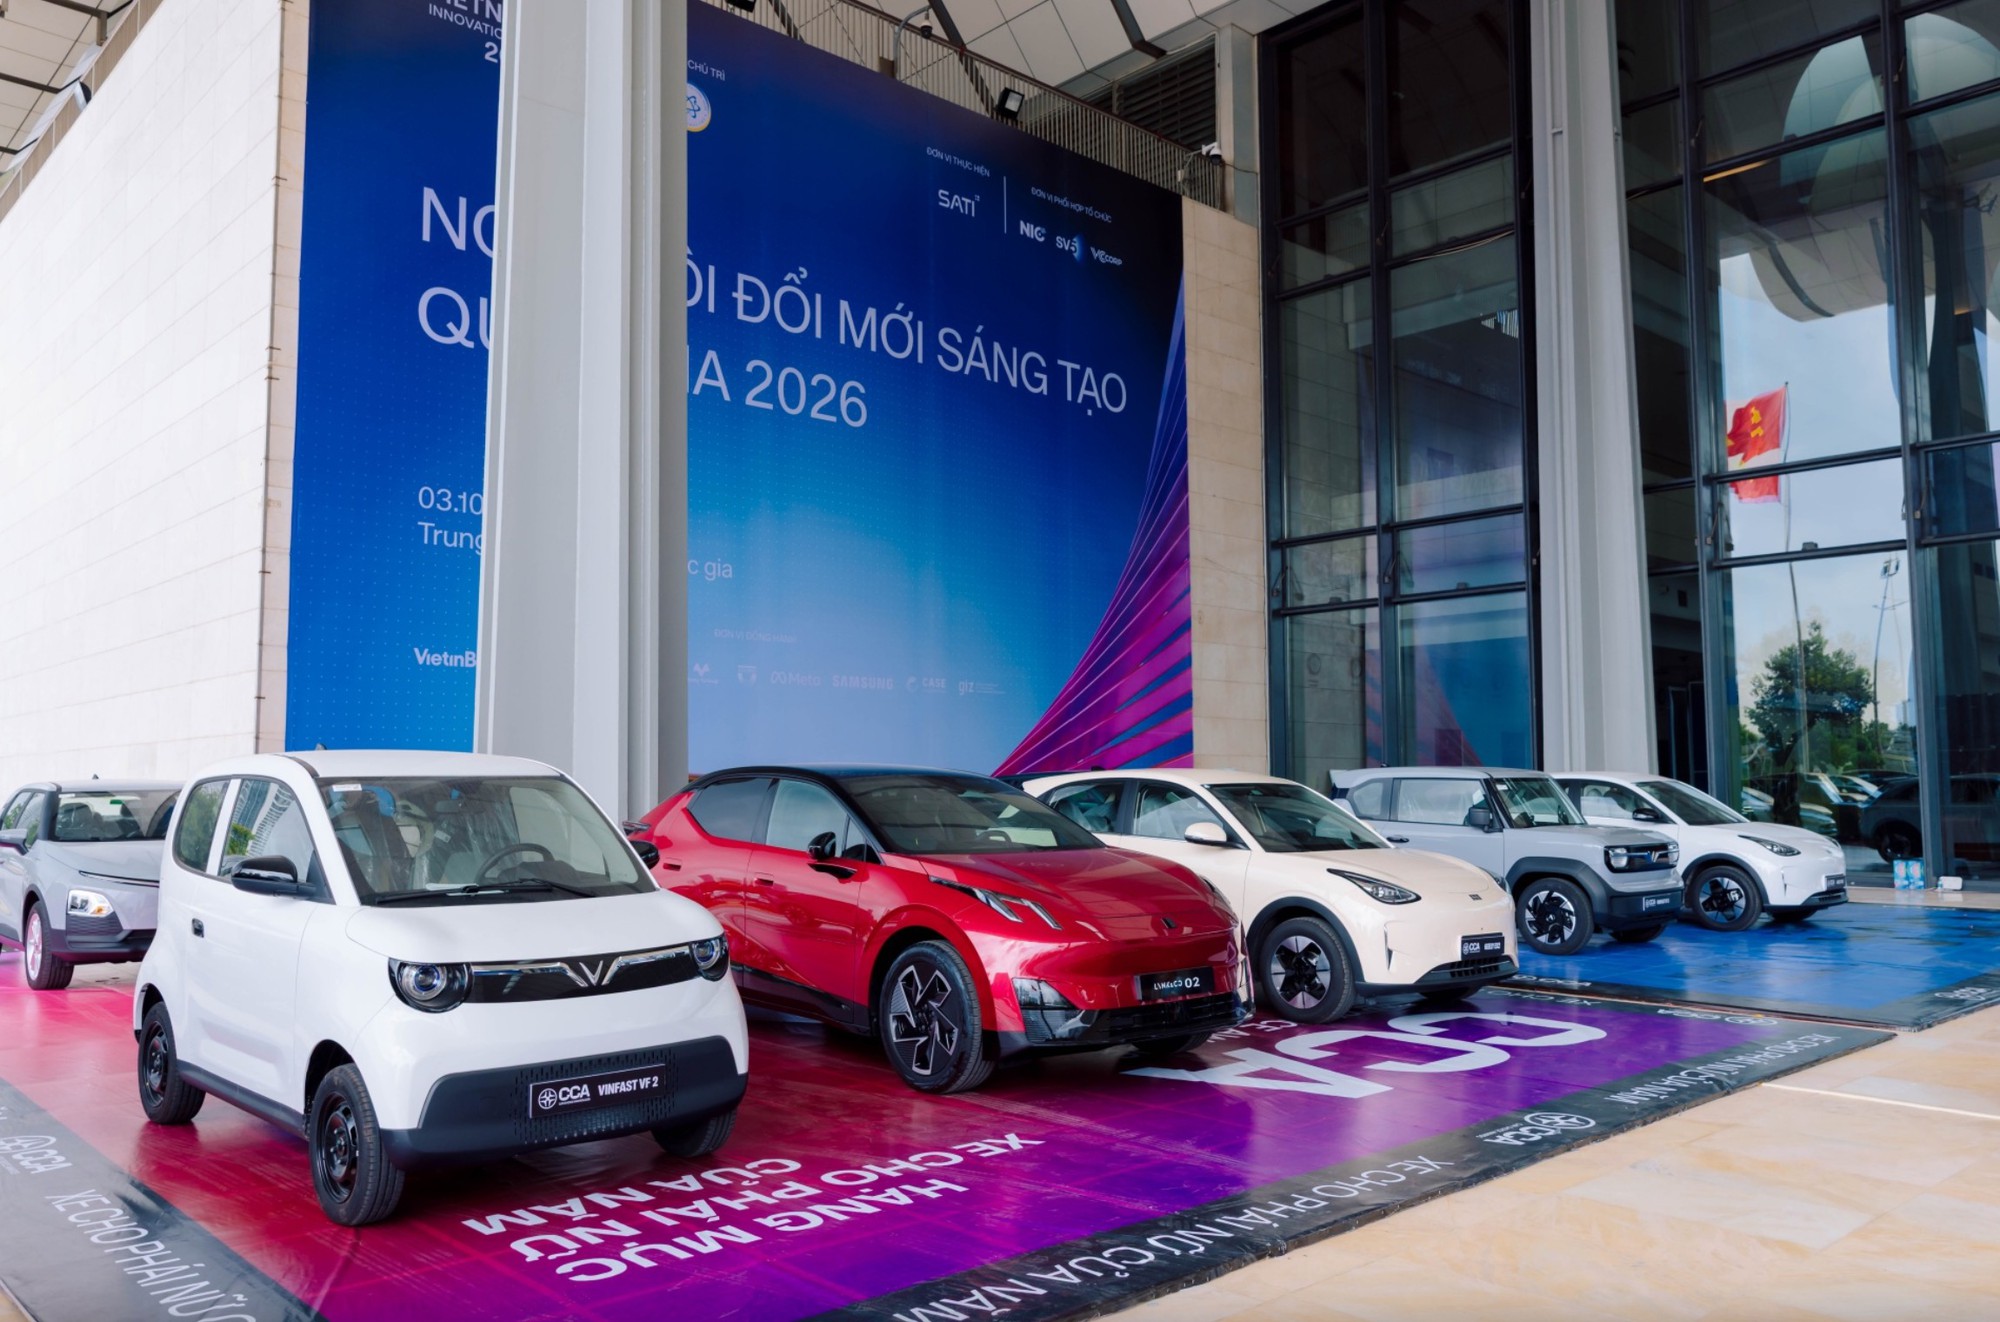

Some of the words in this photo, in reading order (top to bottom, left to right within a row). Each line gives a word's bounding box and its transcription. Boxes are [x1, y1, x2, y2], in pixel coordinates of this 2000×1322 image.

[484, 41, 501, 64] 2
[938, 189, 975, 217] SATI
[1020, 219, 1046, 242] NIC
[732, 266, 822, 339] ĐỔI
[839, 302, 924, 364] MỚI
[937, 324, 1048, 396] SÁNG
[1056, 359, 1127, 416] TẠO
[745, 359, 868, 428] 2026
[704, 557, 733, 581] gia
[832, 674, 895, 690] SAMSUNG
[1184, 976, 1201, 988] 02
[558, 1084, 591, 1101] CCA
[598, 1079, 638, 1096] VINFAST
[638, 1077, 651, 1089] VF
[652, 1075, 659, 1087] 2
[951, 1133, 1047, 1158] XE
[1482, 1126, 1556, 1146] CCA
[11, 1148, 73, 1174] CCA
[647, 1158, 802, 1192] CỦA
[820, 1151, 964, 1187] CHO
[1387, 1155, 1455, 1175] XE
[45, 1188, 111, 1212] XE
[1312, 1169, 1407, 1199] CHO
[461, 1186, 656, 1236] NĂM
[638, 1181, 823, 1227] PHÁI
[754, 1178, 970, 1233] HẠNG
[1215, 1193, 1330, 1231] PHÁI
[68, 1208, 149, 1246] CHO
[510, 1220, 643, 1263] NỮ
[1146, 1224, 1234, 1256] NỮ
[104, 1240, 205, 1288] PHÁI
[555, 1225, 763, 1282] MỤC
[1032, 1246, 1156, 1284] CỦA
[150, 1280, 249, 1318] NỮ
[893, 1278, 1049, 1322] NĂM
